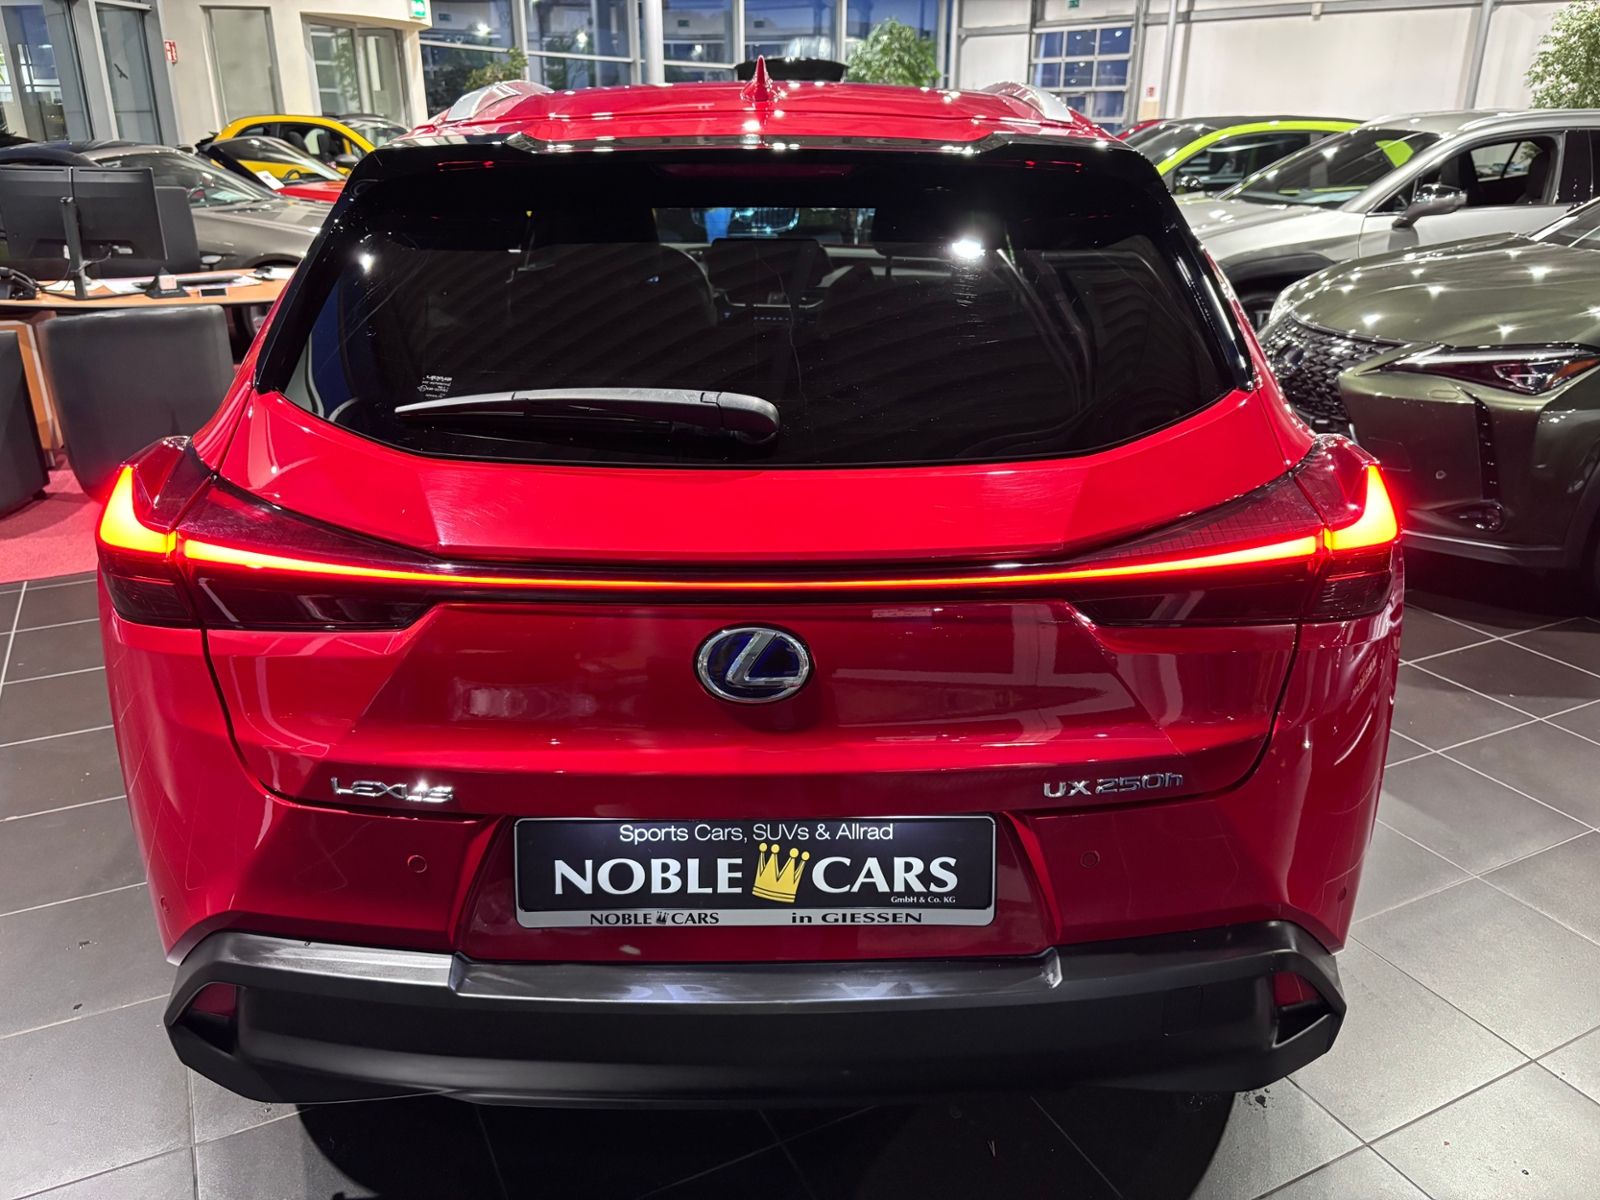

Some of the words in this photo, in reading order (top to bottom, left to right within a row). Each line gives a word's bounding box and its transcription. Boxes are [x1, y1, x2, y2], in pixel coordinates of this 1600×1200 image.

[331, 777, 453, 803] LEXUS
[1043, 780, 1092, 798] UX
[1095, 772, 1184, 794] 250h
[619, 824, 689, 846] Sports
[694, 823, 748, 844] Cars,
[752, 823, 810, 841] SUVs
[815, 823, 831, 841] &
[835, 823, 894, 841] Allrad
[554, 857, 743, 895] NOBLE
[811, 856, 958, 893] CARS
[890, 895, 917, 904] GmbH
[919, 896, 925, 904] &
[927, 896, 941, 904] Co.
[943, 896, 956, 904] KG
[590, 913, 652, 925] NOBLE
[671, 912, 720, 925] CARS
[791, 912, 813, 924] in
[821, 912, 923, 924] GIESSEN
